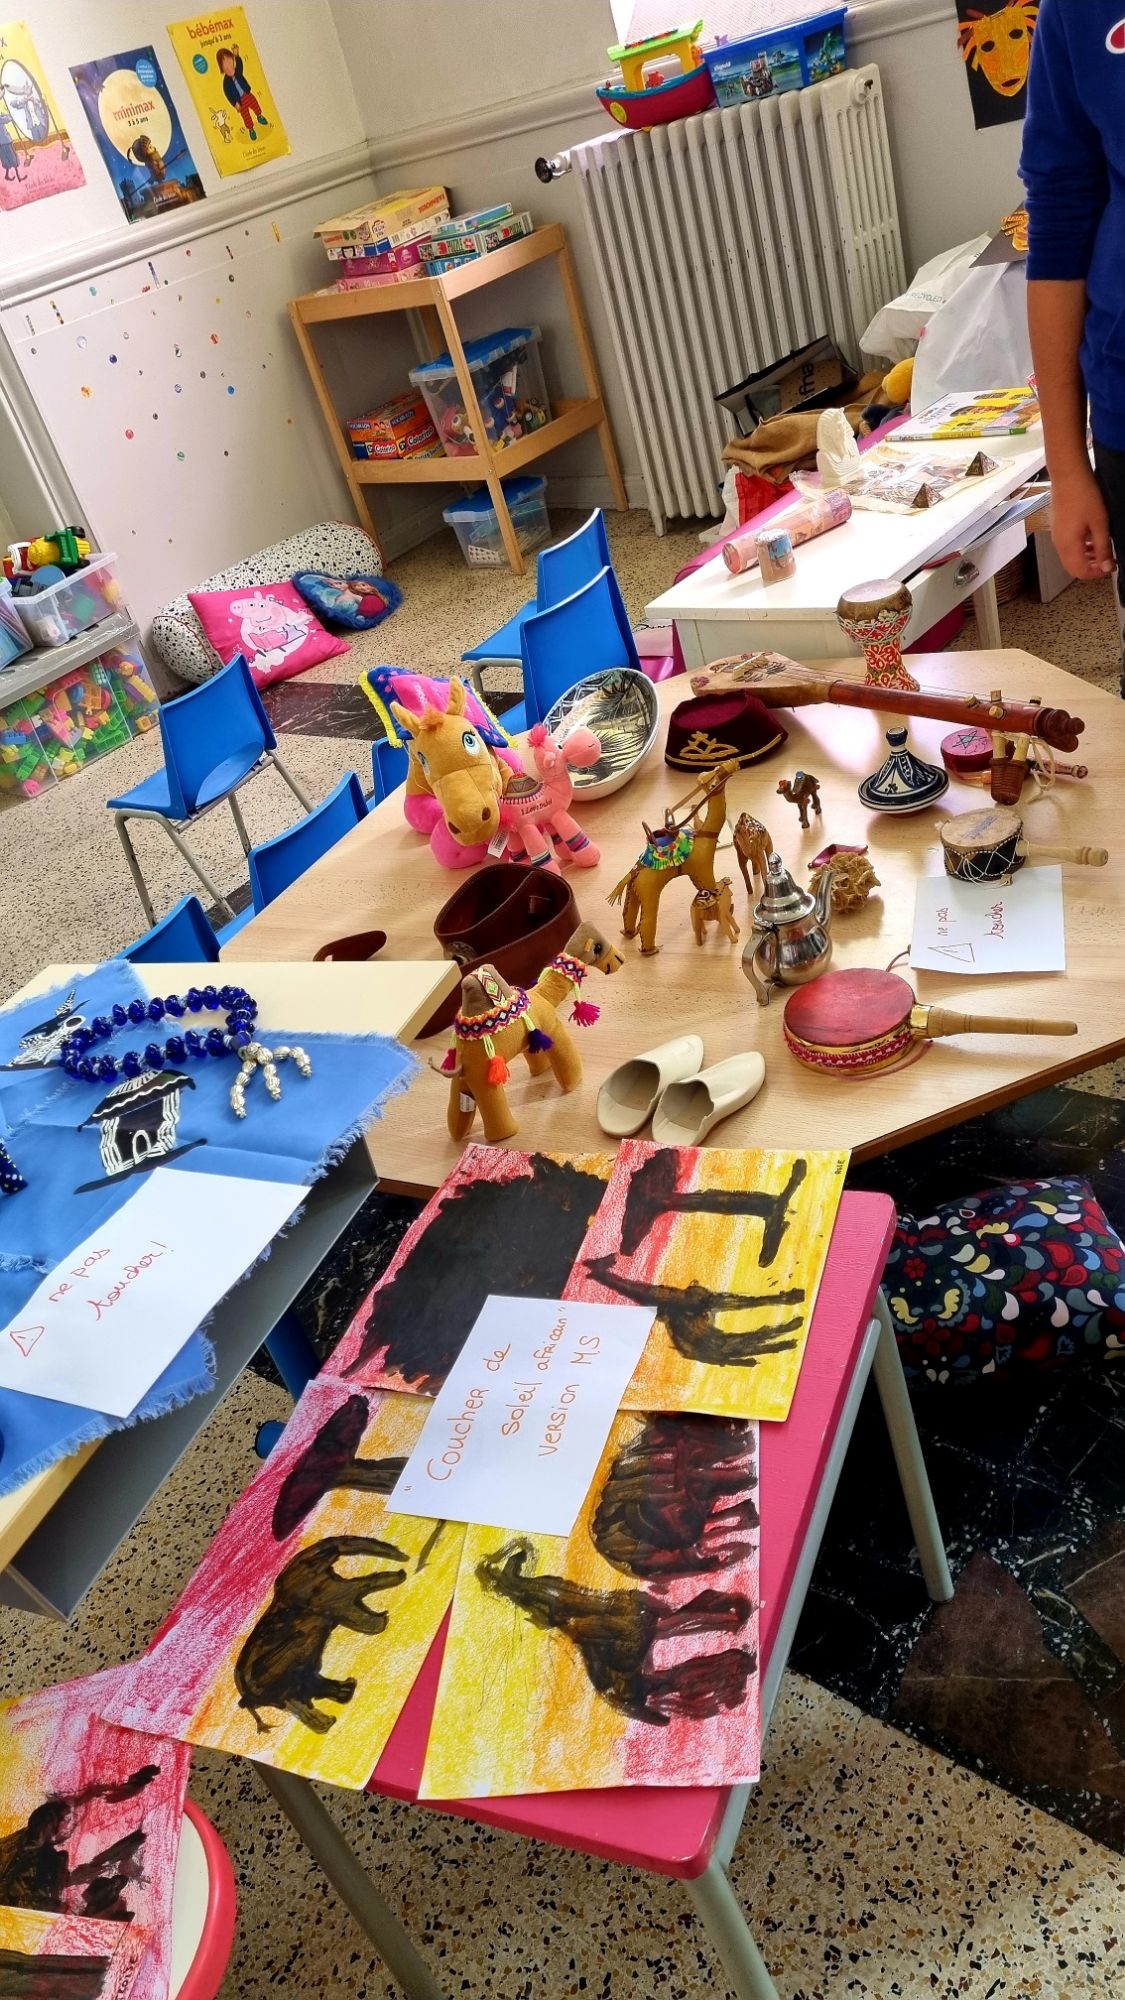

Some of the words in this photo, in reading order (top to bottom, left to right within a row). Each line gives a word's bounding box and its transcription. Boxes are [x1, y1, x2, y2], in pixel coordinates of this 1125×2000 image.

[186, 18, 234, 39] bébémax
[112, 101, 155, 121] minimax
[936, 907, 957, 924] pas
[936, 927, 949, 937] ne
[49, 1282, 73, 1302] ne
[71, 1248, 111, 1278] pas
[483, 1344, 512, 1373] de
